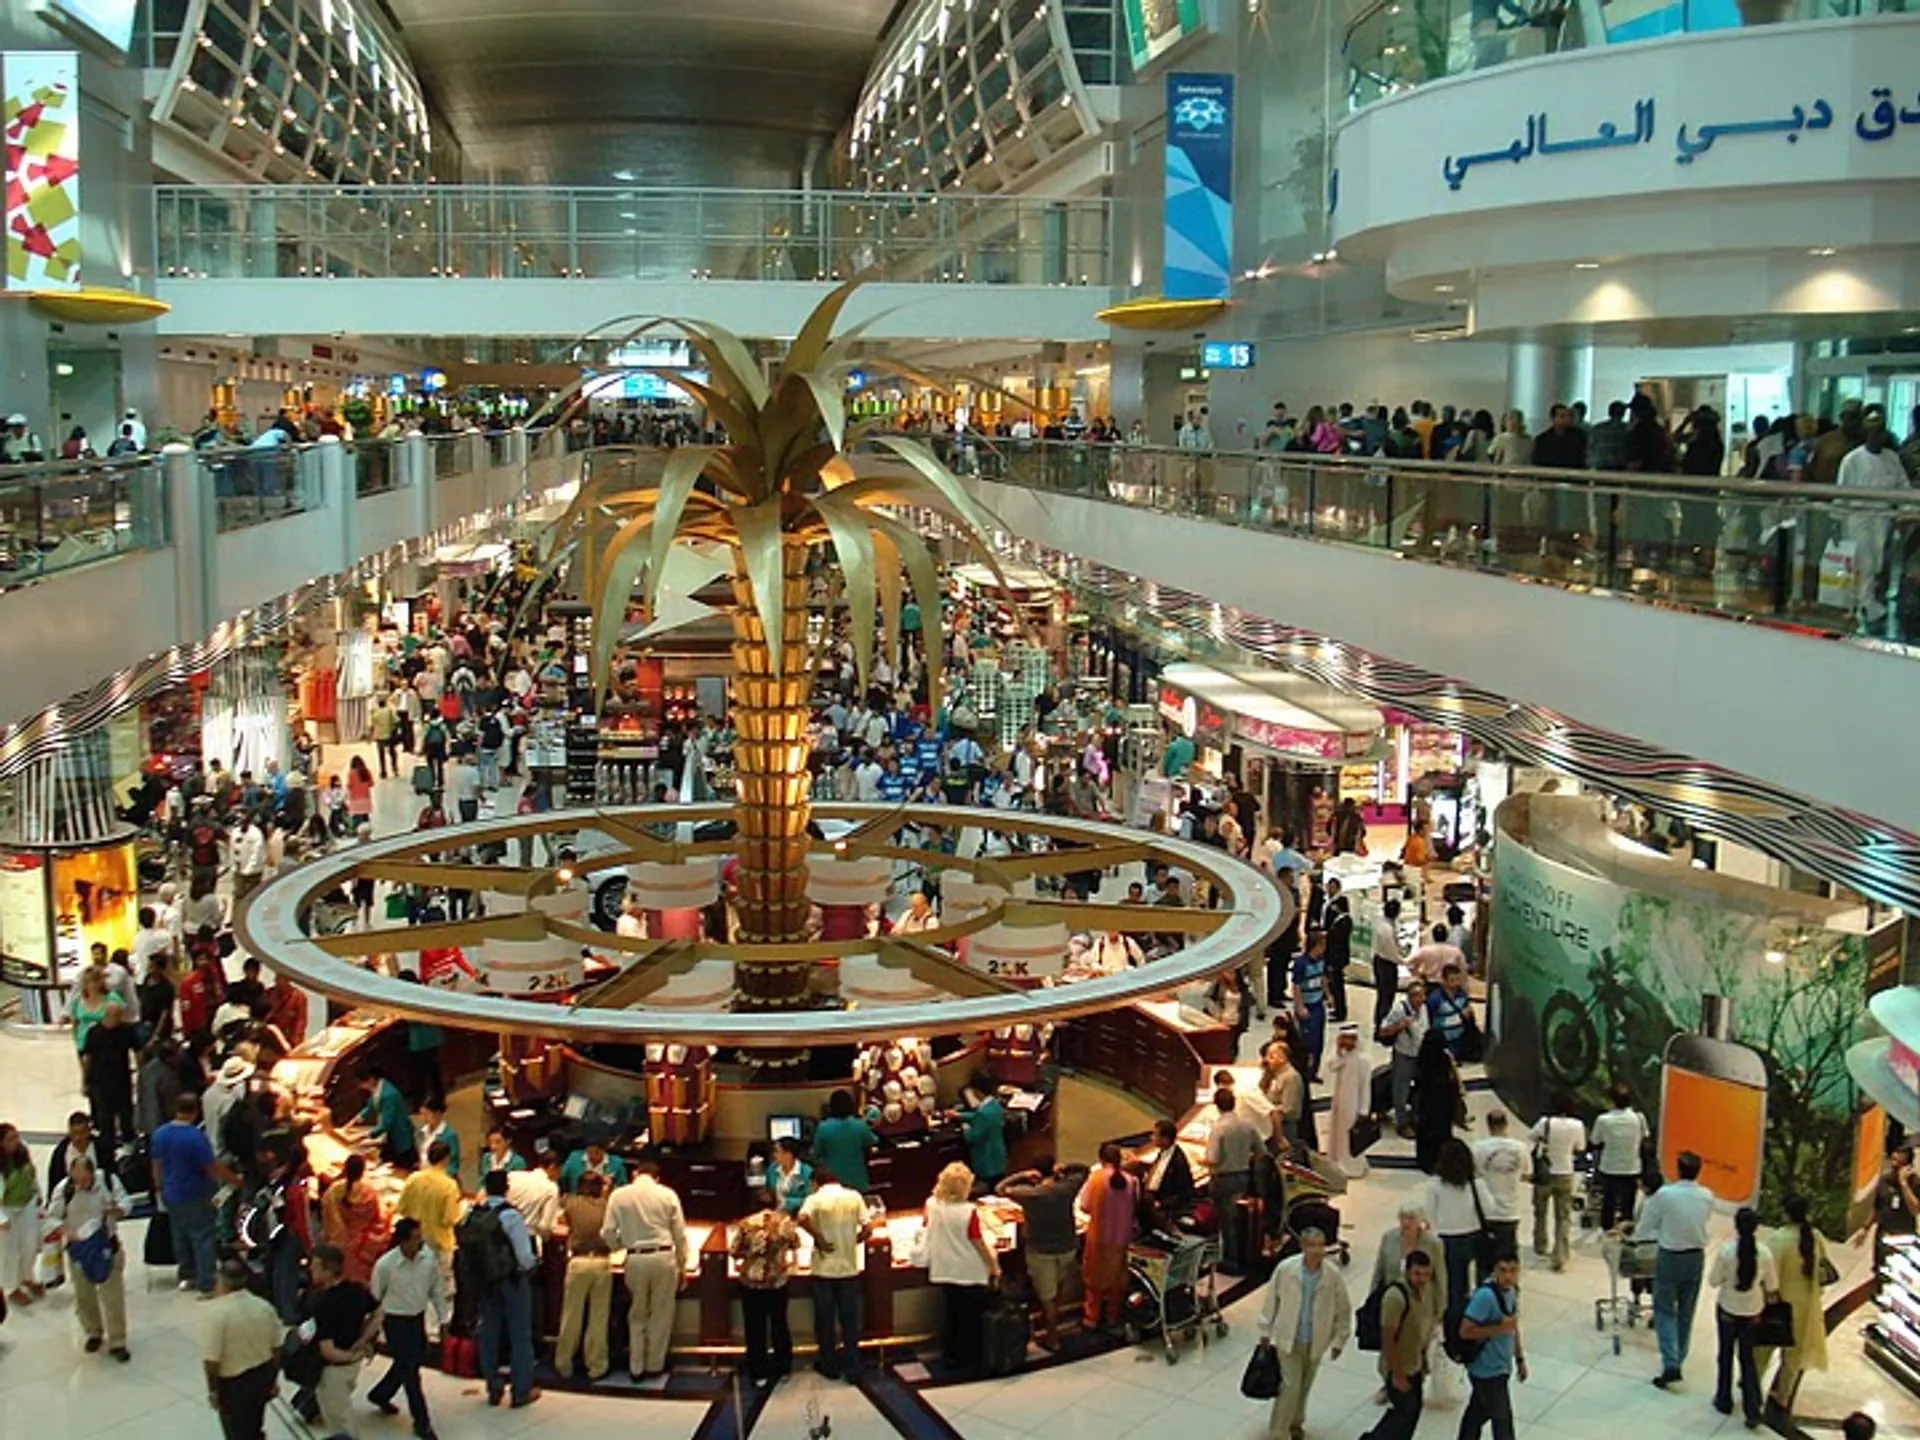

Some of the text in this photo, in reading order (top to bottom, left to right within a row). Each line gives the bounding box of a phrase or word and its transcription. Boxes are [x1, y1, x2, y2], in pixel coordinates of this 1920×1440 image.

[1443, 98, 1655, 190] العالمي
[1676, 98, 1833, 165] دبي
[1229, 344, 1249, 367] 15
